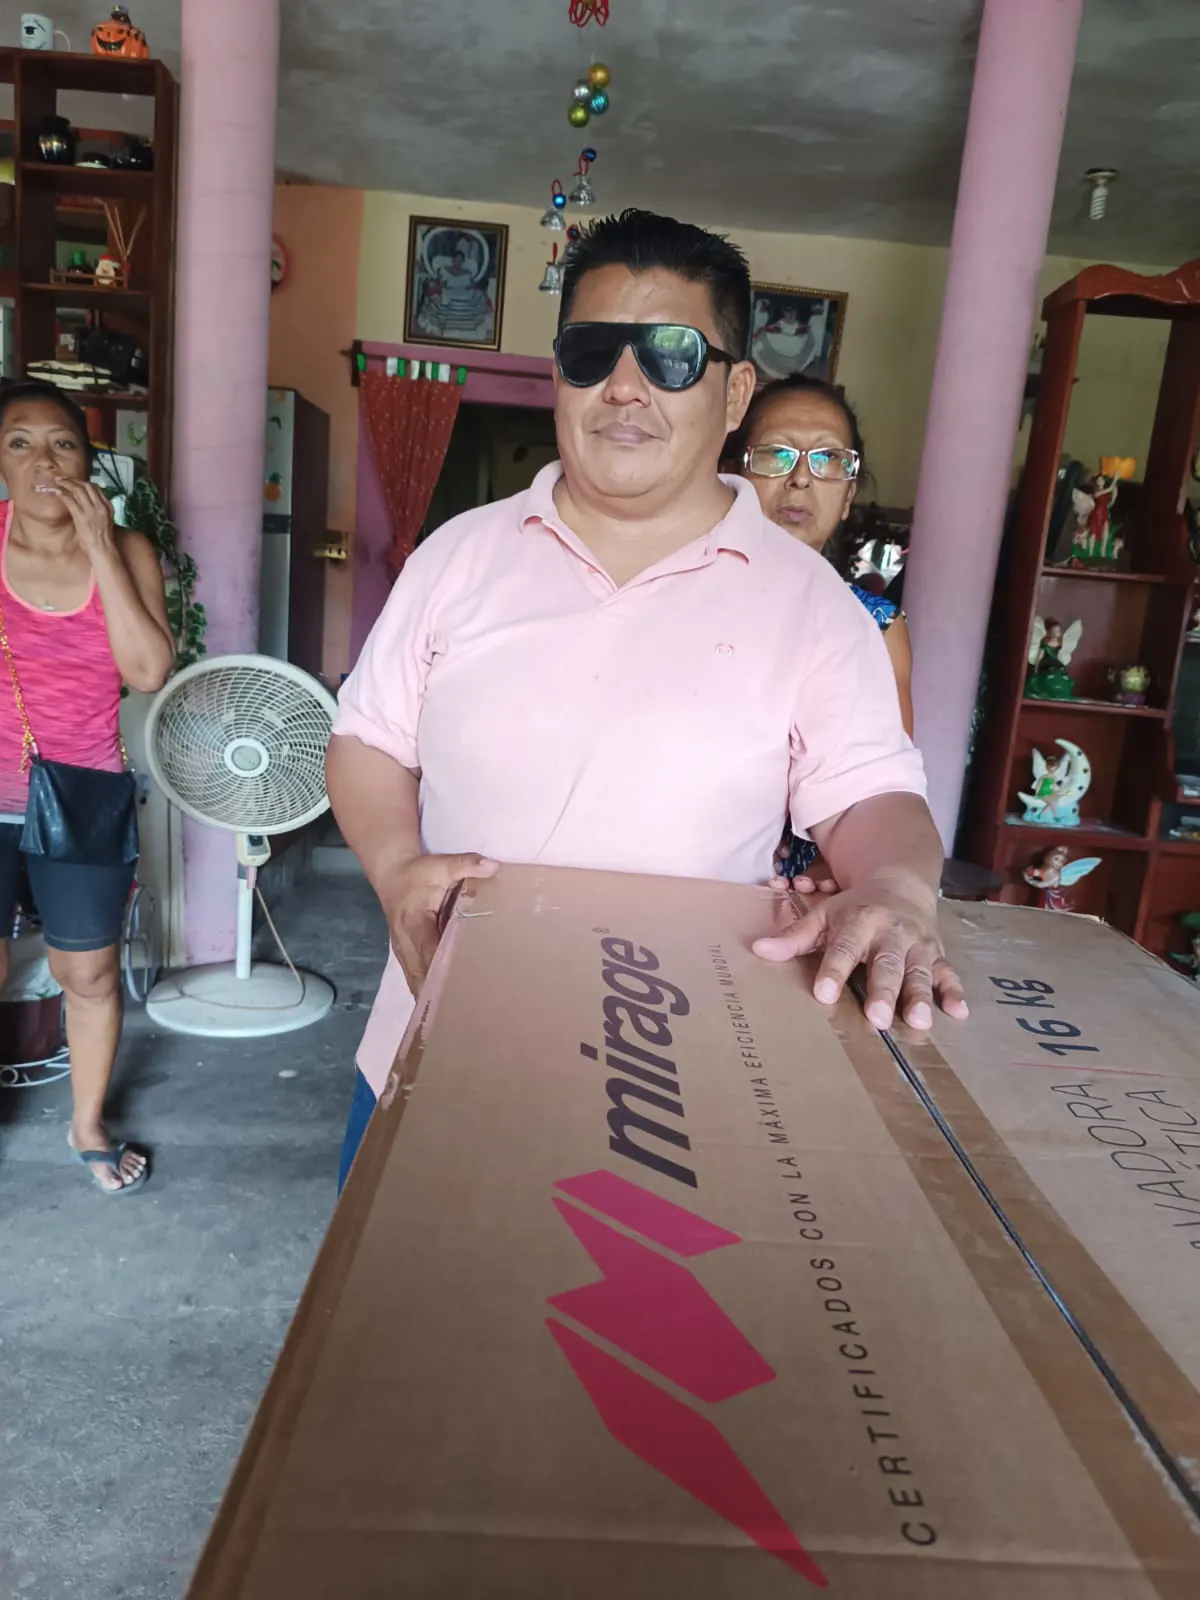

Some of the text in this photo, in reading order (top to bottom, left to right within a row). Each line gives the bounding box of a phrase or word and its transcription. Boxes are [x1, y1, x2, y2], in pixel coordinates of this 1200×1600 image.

[580, 937, 698, 1189] mirage
[1016, 1017, 1100, 1057] 16
[708, 944, 937, 1547] CERTIFICADOS CON LA MÁXIMA EFICIENCIA MUNDIAL
